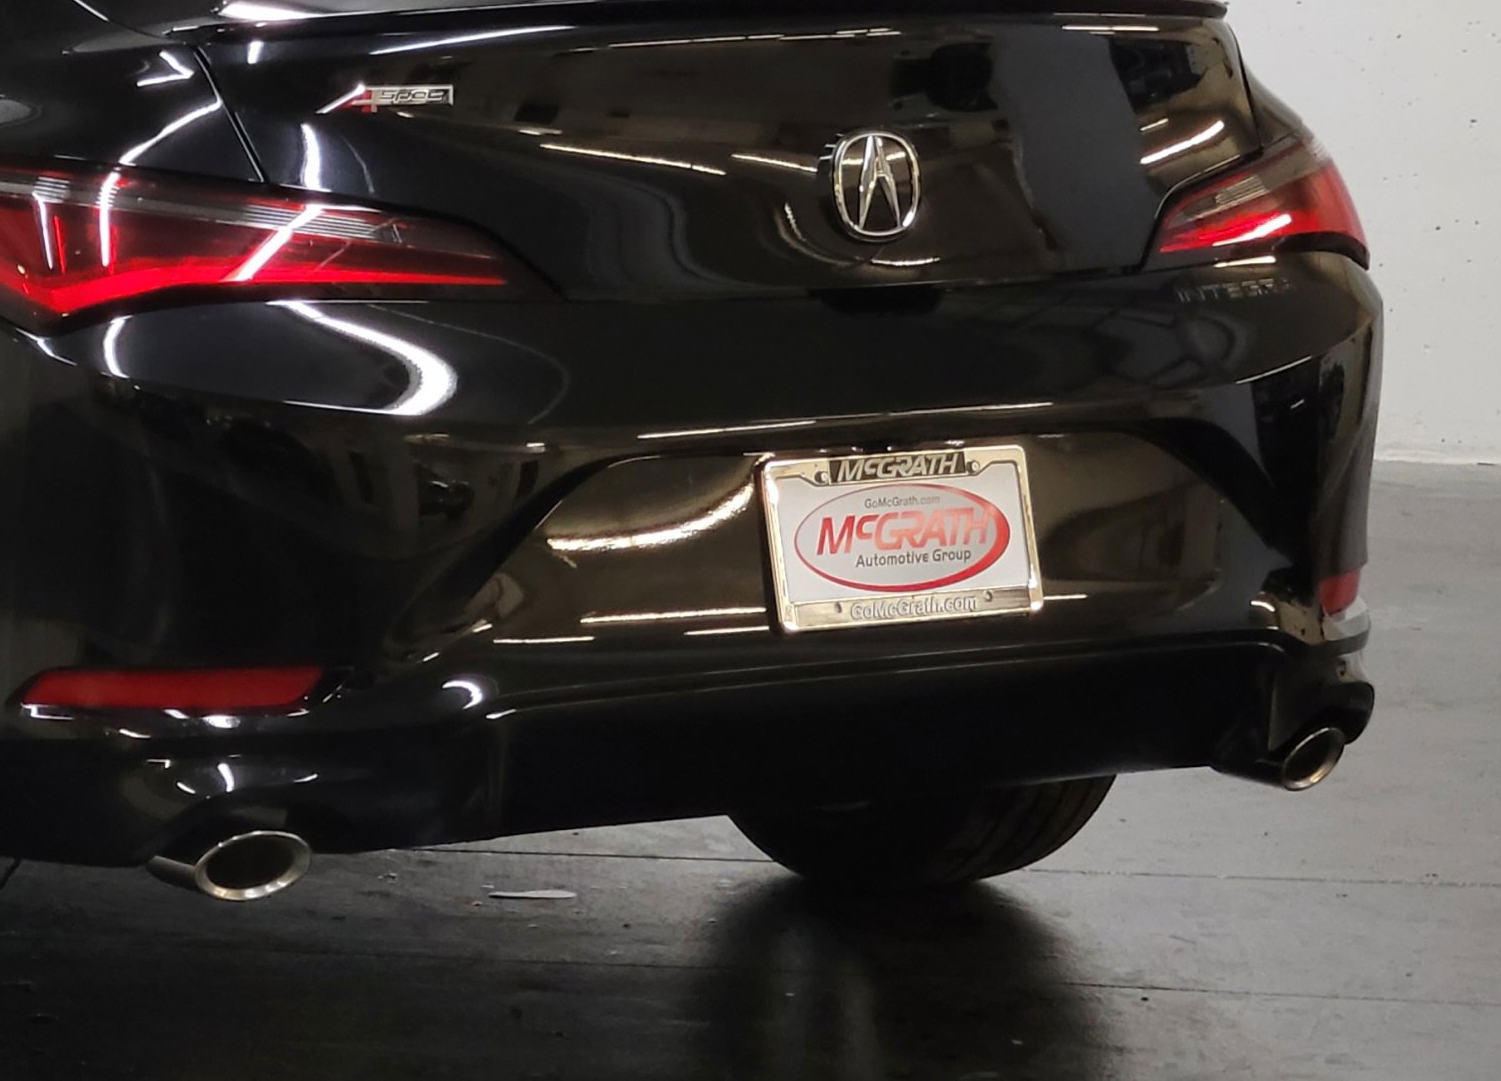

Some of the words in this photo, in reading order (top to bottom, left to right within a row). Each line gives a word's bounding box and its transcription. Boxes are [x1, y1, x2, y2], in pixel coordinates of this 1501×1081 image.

[864, 495, 941, 510] GoMcGrath.com
[855, 551, 929, 569] Automotive
[932, 548, 972, 564] Group
[850, 595, 978, 620] GoMcGrath.com
